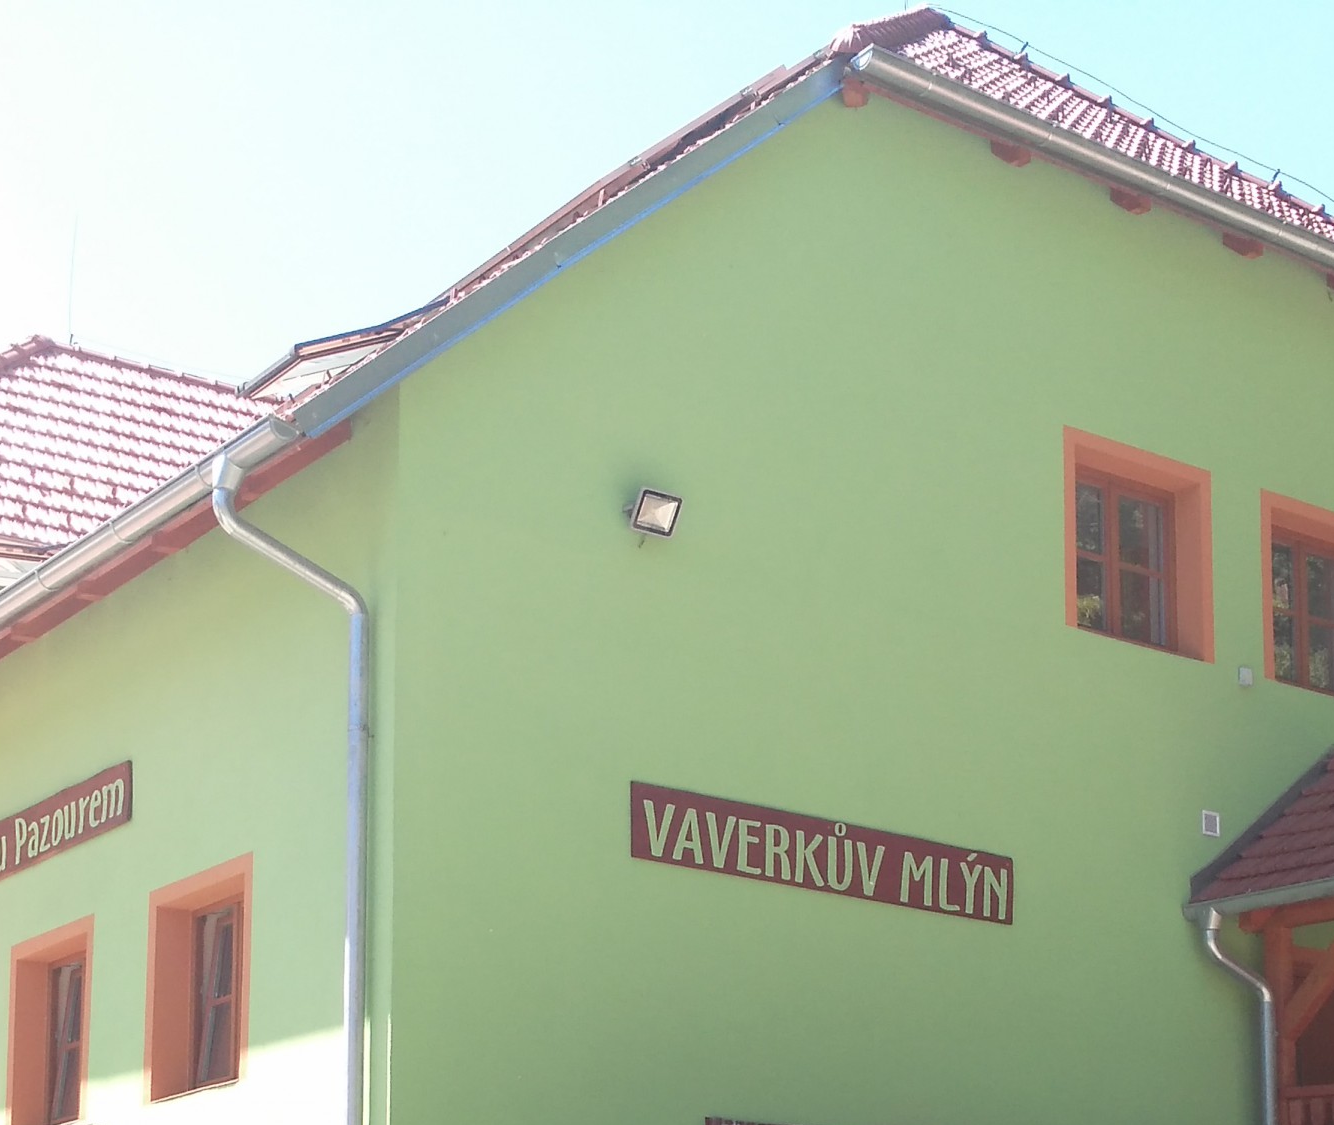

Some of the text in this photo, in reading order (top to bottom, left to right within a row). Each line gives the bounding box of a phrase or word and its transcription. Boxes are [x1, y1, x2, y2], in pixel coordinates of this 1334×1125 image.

[15, 778, 125, 865] Pazourem
[643, 799, 1008, 920] VAVERKŮV MLÝN
